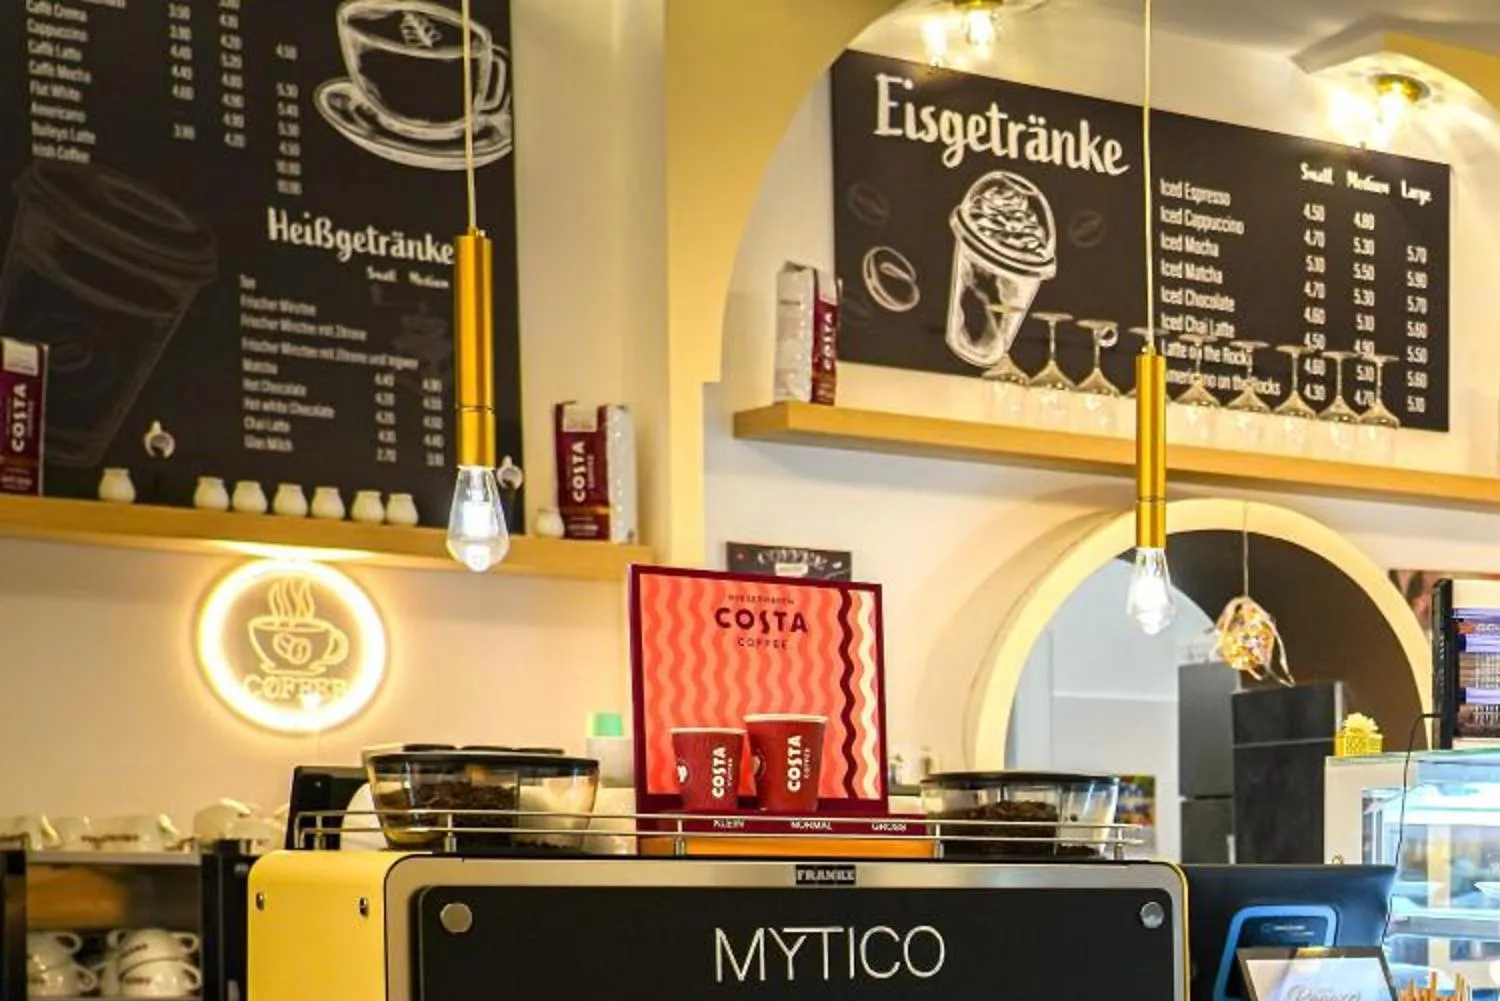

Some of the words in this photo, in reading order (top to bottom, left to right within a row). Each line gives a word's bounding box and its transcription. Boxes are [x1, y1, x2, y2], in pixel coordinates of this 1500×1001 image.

[873, 73, 1131, 176] Eisgetränke
[1160, 178, 1183, 199] Iced
[1184, 181, 1231, 207] Espresso
[1299, 162, 1335, 186] Small
[1345, 169, 1391, 195] Medium
[1400, 179, 1433, 206] Large
[267, 206, 455, 265] Heißgetränke
[1160, 206, 1183, 225] Iced
[1184, 209, 1245, 235] Cappuccino
[1303, 229, 1325, 248] 4.70
[1406, 245, 1427, 264] 5.70
[1161, 232, 1183, 252] Iced
[1185, 235, 1219, 257] Mocha
[1161, 259, 1183, 279] Iced
[1185, 262, 1223, 284] Matcha
[1303, 281, 1325, 299] 4.70
[1161, 286, 1183, 305] Iced
[1185, 289, 1236, 312] Chocolate
[1161, 312, 1183, 332] Iced
[1185, 315, 1208, 334] Chai
[1209, 318, 1235, 339] Latte
[1161, 339, 1187, 359] Latte
[1203, 345, 1221, 363] the
[1166, 369, 1217, 389] mericano
[1217, 375, 1231, 391] on
[12, 384, 27, 453] COSTA
[571, 441, 587, 503] COSTA
[714, 606, 808, 634] COSTA
[737, 637, 788, 650] COFFEE
[712, 747, 727, 798] COSTA
[787, 735, 803, 792] COSTA
[797, 869, 855, 882] FRANKE
[714, 925, 946, 982] MYTICO
